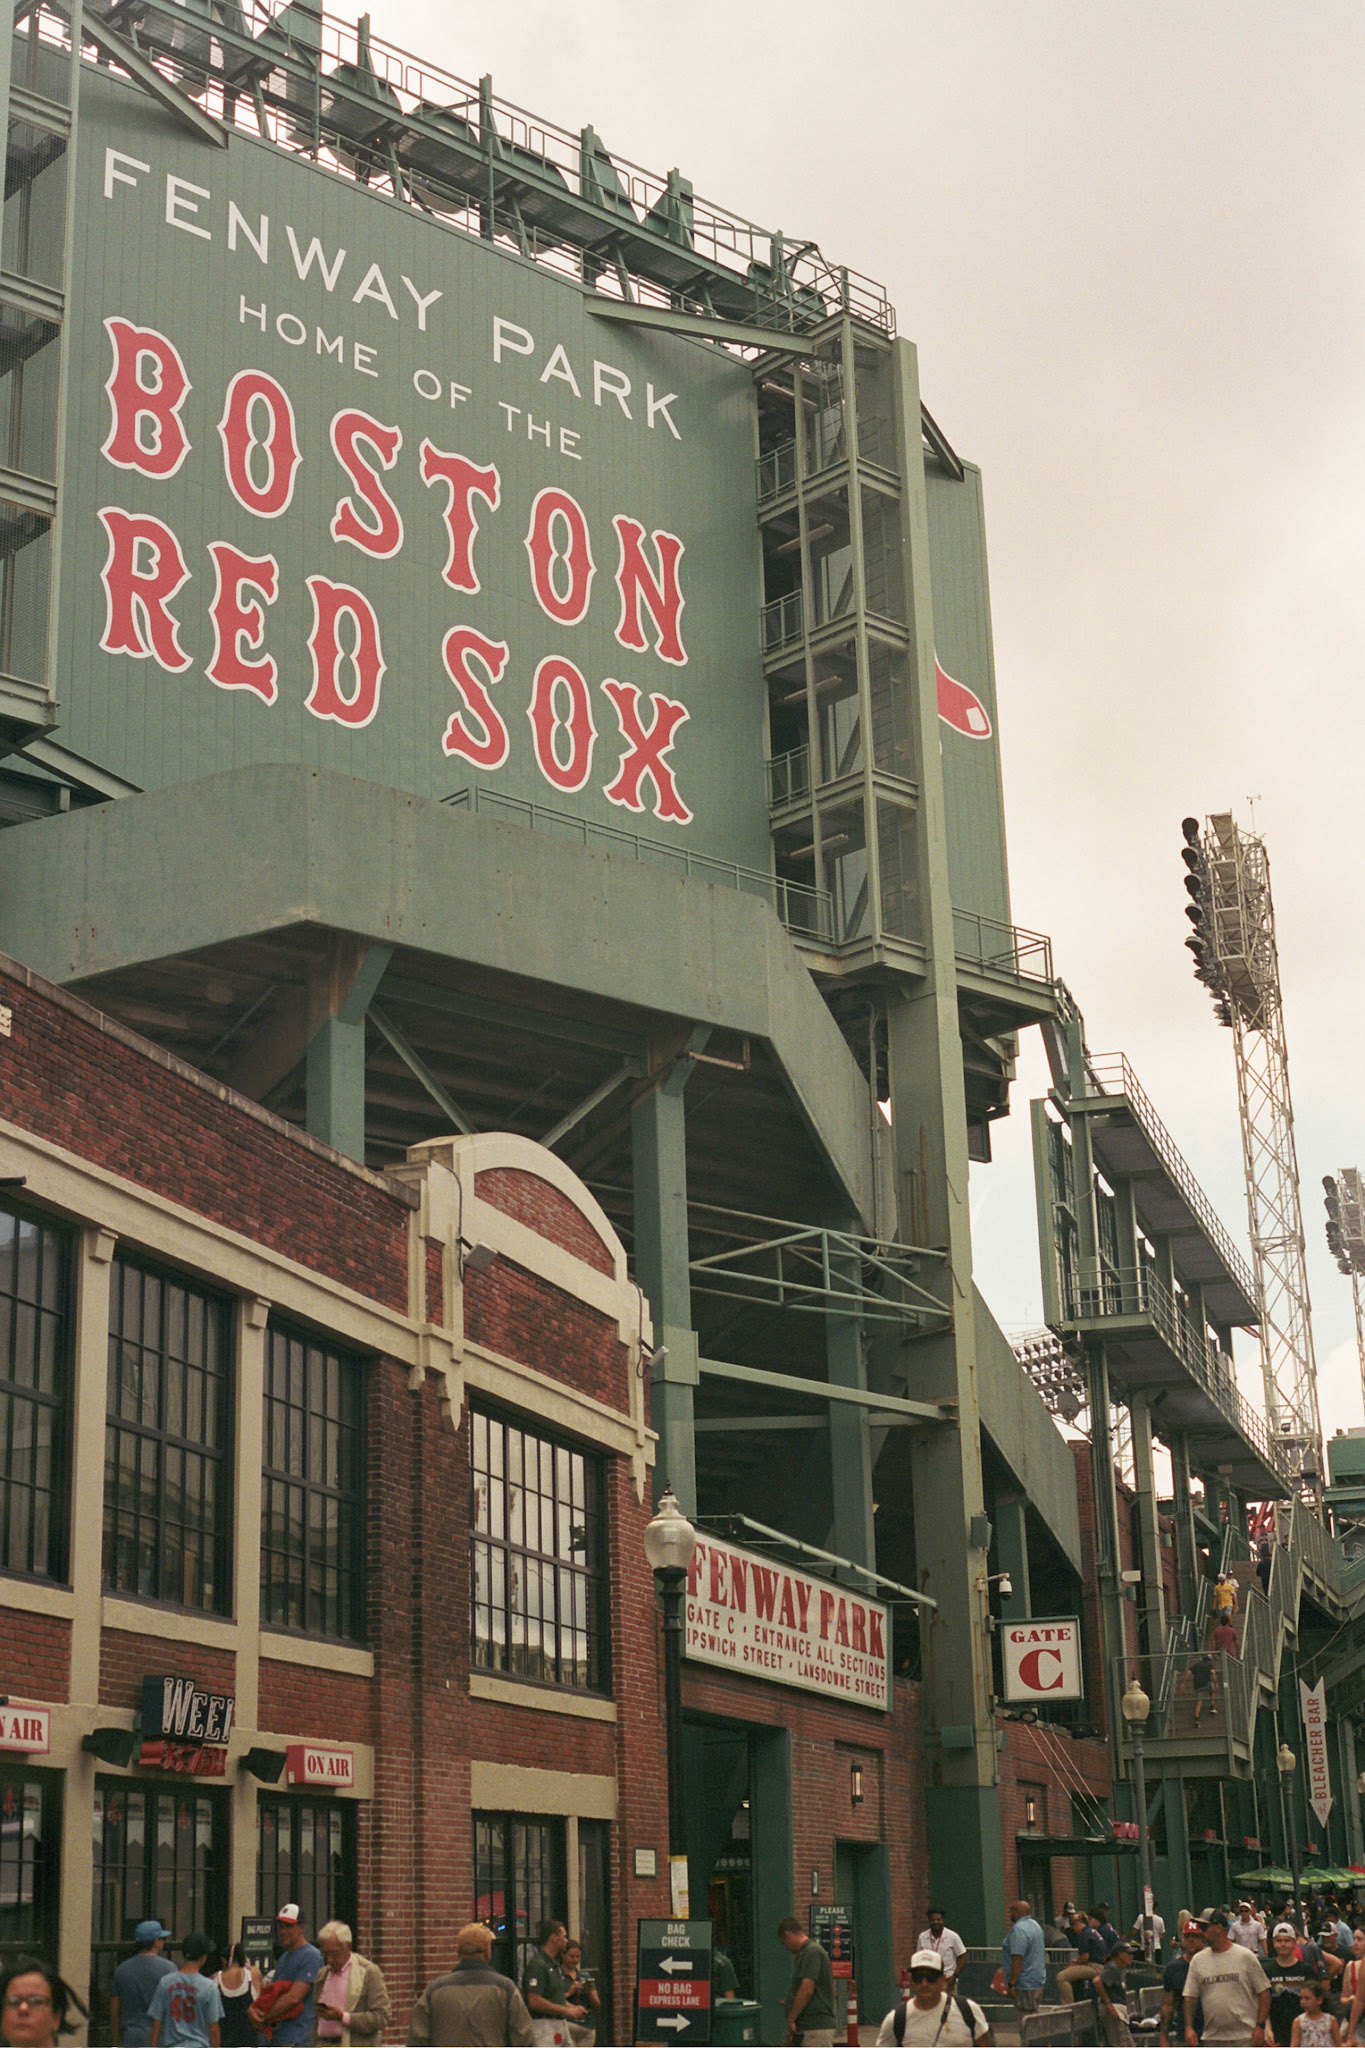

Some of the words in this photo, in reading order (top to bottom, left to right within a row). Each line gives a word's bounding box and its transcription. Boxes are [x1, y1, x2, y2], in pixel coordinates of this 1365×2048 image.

[102, 147, 444, 331] FENWAY
[492, 316, 682, 440] PARK
[238, 295, 379, 377] HOME
[413, 369, 472, 409] OF
[498, 401, 582, 460] THE
[100, 316, 688, 666] BOSTON
[97, 506, 387, 729] RED
[442, 624, 693, 825] SOX
[687, 1541, 812, 1633] FENWAY
[819, 1589, 885, 1660] PARK
[687, 1603, 720, 1630] GATE
[728, 1616, 735, 1635] C
[754, 1625, 812, 1658] ENTRANCE
[817, 1645, 835, 1666] ALL
[840, 1653, 885, 1681] SECTIONS
[1010, 1628, 1071, 1643] GATE
[687, 1628, 736, 1658] IPSWICH
[743, 1645, 783, 1671] STREET
[798, 1661, 850, 1690] LANSDOWNE
[855, 1679, 885, 1700] STREET
[1018, 1649, 1064, 1691] C
[1307, 1698, 1321, 1724] BAR
[9, 1717, 43, 1742] AIR
[307, 1755, 325, 1774] ON
[327, 1758, 350, 1777] AIR
[1310, 1730, 1327, 1800] BLEACHER
[820, 1906, 845, 1914] PLEASE
[247, 1925, 256, 1934] BAG
[257, 1925, 271, 1933] POLICY
[661, 1936, 690, 1948] CHECK
[667, 1923, 685, 1935] BAG
[649, 1996, 681, 2006] EXPRESS
[682, 1996, 700, 2006] LANE
[658, 1983, 671, 1994] NO
[673, 1983, 692, 1994] BAG
[168, 1995, 196, 2024] 46
